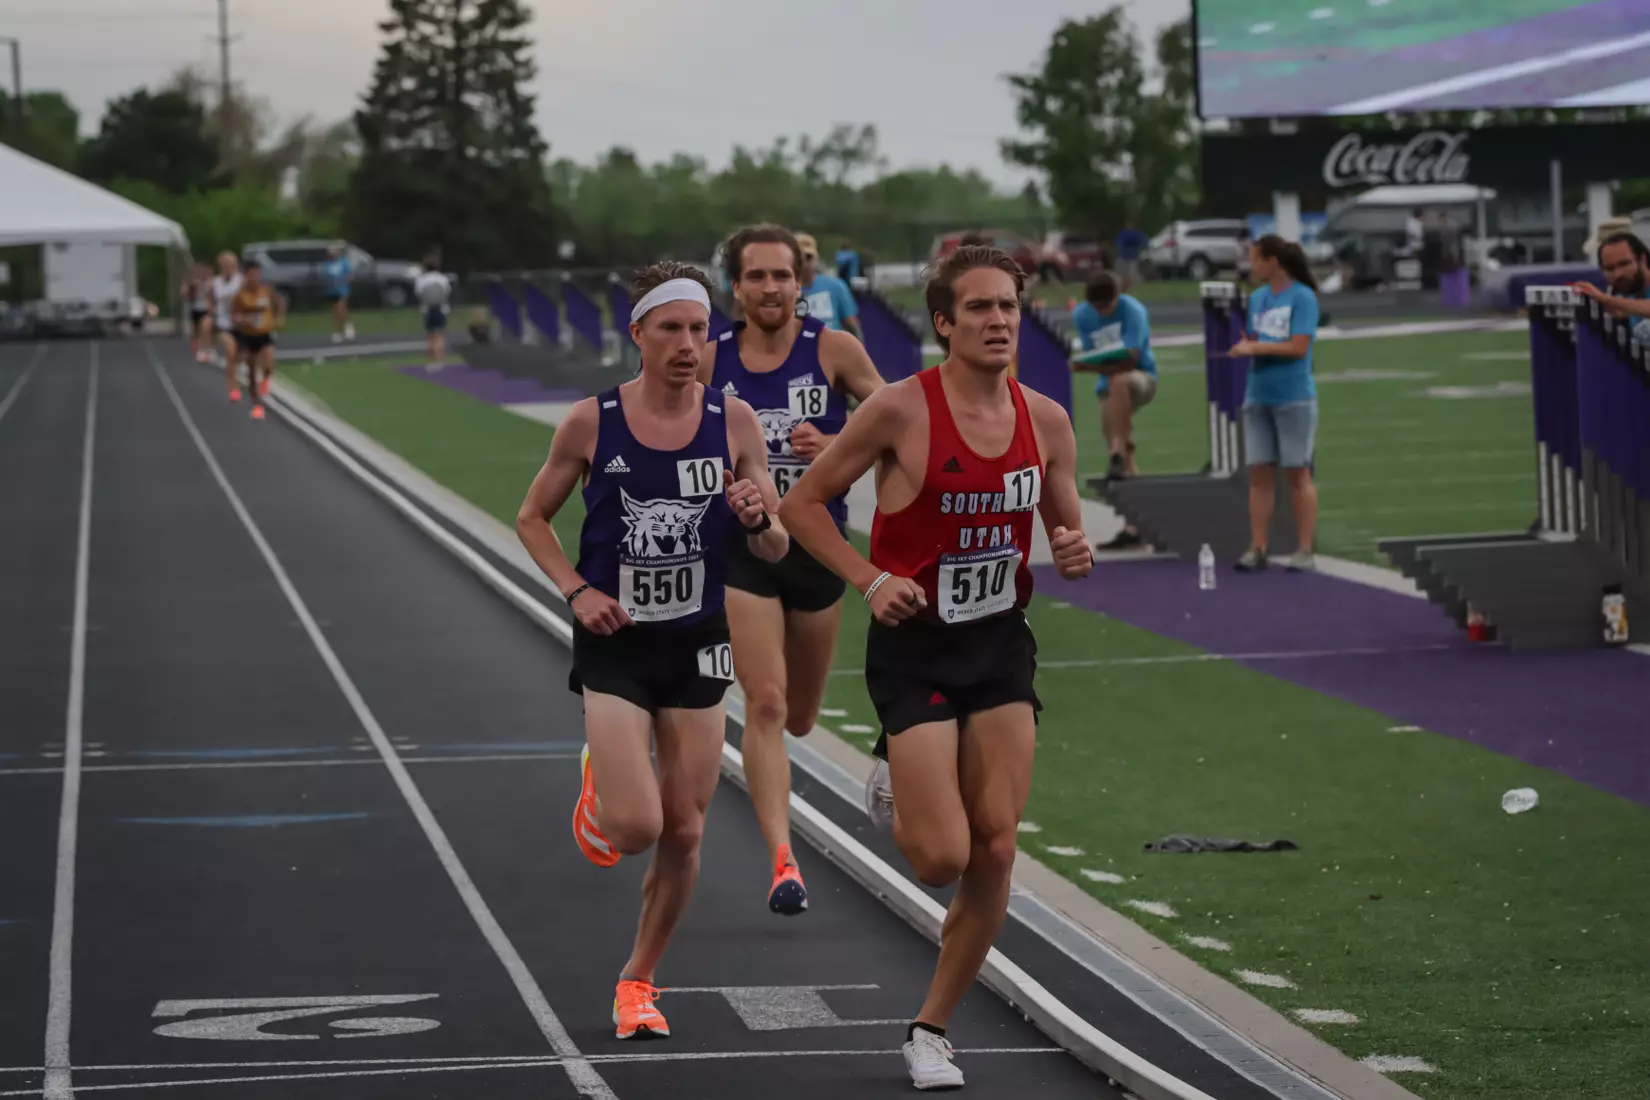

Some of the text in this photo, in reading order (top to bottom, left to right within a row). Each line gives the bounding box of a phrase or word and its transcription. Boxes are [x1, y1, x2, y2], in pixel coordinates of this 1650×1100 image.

[795, 387, 822, 416] 18
[685, 459, 718, 494] 10
[1011, 469, 1035, 507] 17
[940, 492, 1032, 515] SOUTH
[959, 523, 1013, 549] UTAH
[632, 566, 693, 606] 550
[951, 559, 1009, 605] 510
[704, 645, 732, 677] 10
